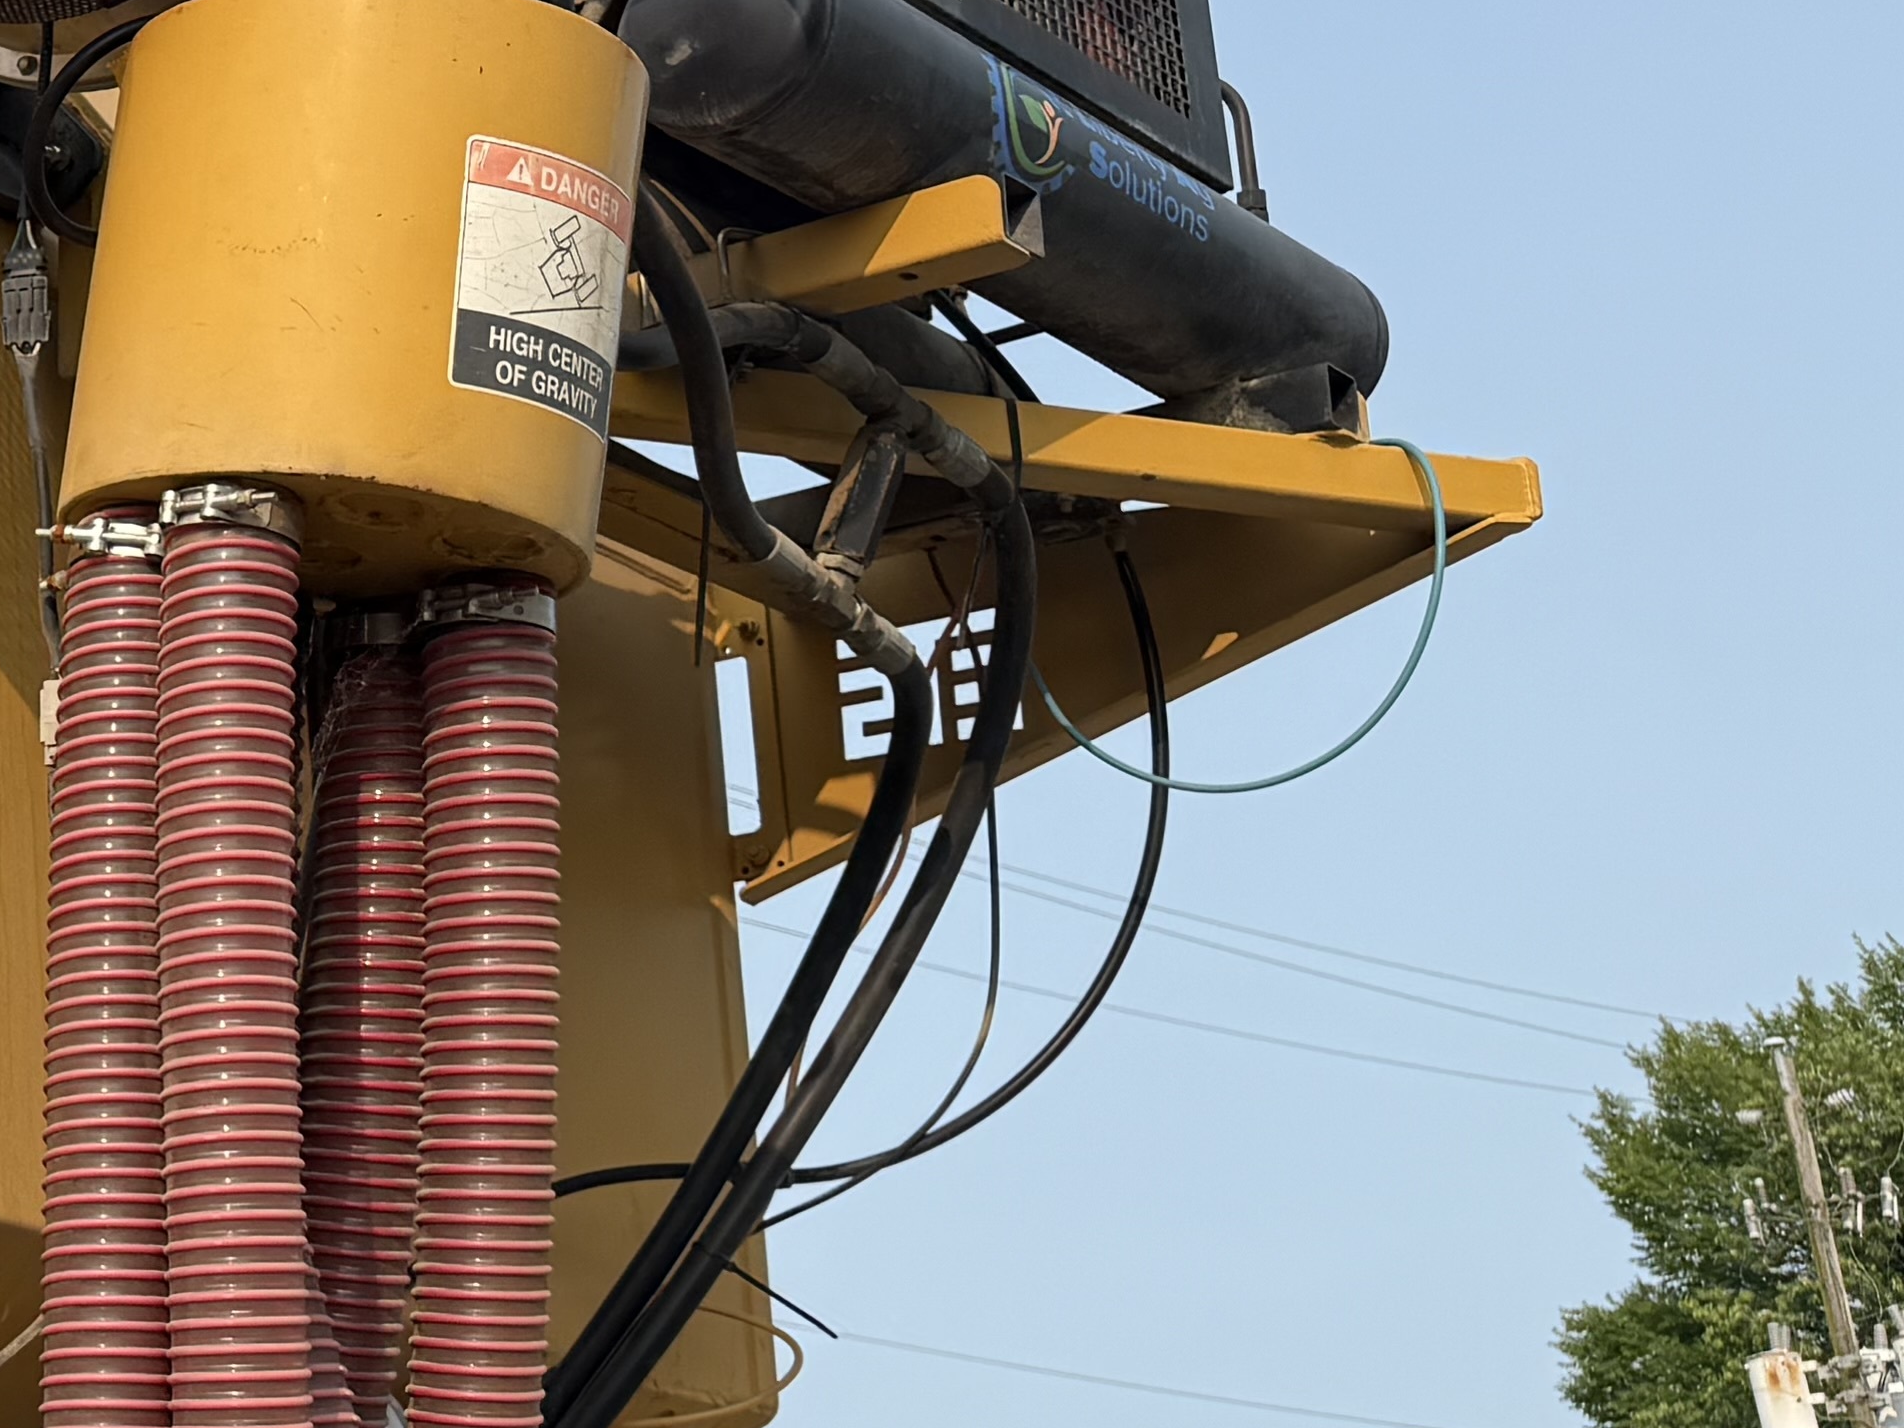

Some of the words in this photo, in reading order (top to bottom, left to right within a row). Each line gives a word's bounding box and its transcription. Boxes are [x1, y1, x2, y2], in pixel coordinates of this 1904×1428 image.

[541, 169, 620, 225] DANGER
[1089, 140, 1210, 242] Solutions
[489, 325, 543, 362] HIGH
[548, 342, 604, 392] CENTER
[496, 360, 526, 387] OF
[532, 371, 597, 419] GRAVITY
